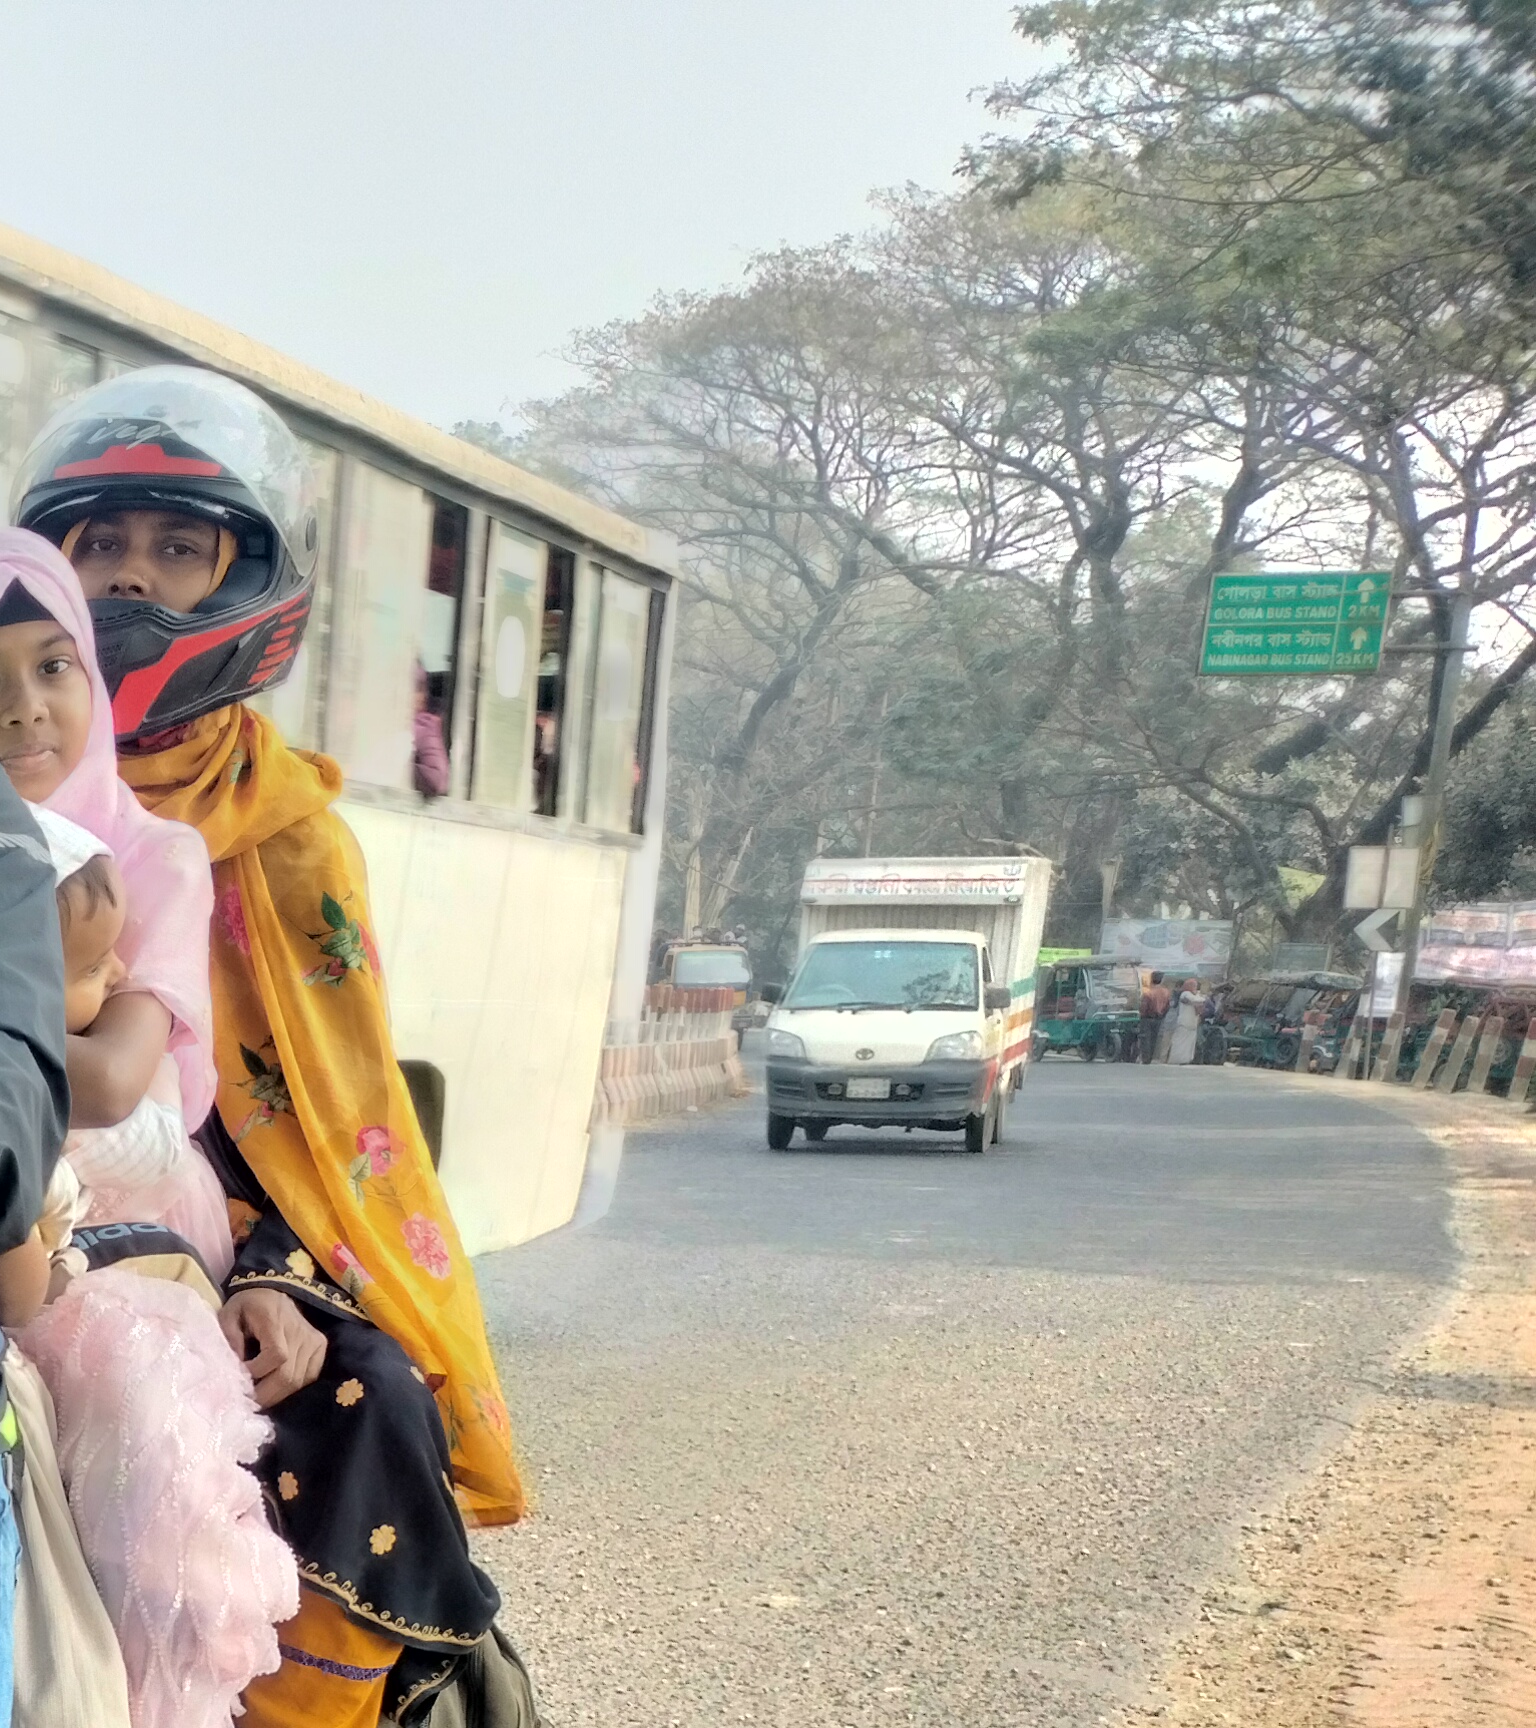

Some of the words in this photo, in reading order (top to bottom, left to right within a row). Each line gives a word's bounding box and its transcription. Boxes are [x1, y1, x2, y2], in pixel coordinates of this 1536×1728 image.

[1273, 585, 1297, 598] বাস
[1214, 606, 1264, 620] GOLORA
[1266, 607, 1292, 619] BUS
[1295, 606, 1337, 619] STAND
[1348, 606, 1357, 618] 2
[1359, 605, 1381, 617] KM
[1211, 629, 1264, 648] নবীনগর
[1267, 633, 1291, 647] বাস
[1207, 653, 1269, 666] NABINAGAR
[1271, 653, 1293, 666] BUS
[1294, 653, 1330, 666] STAND
